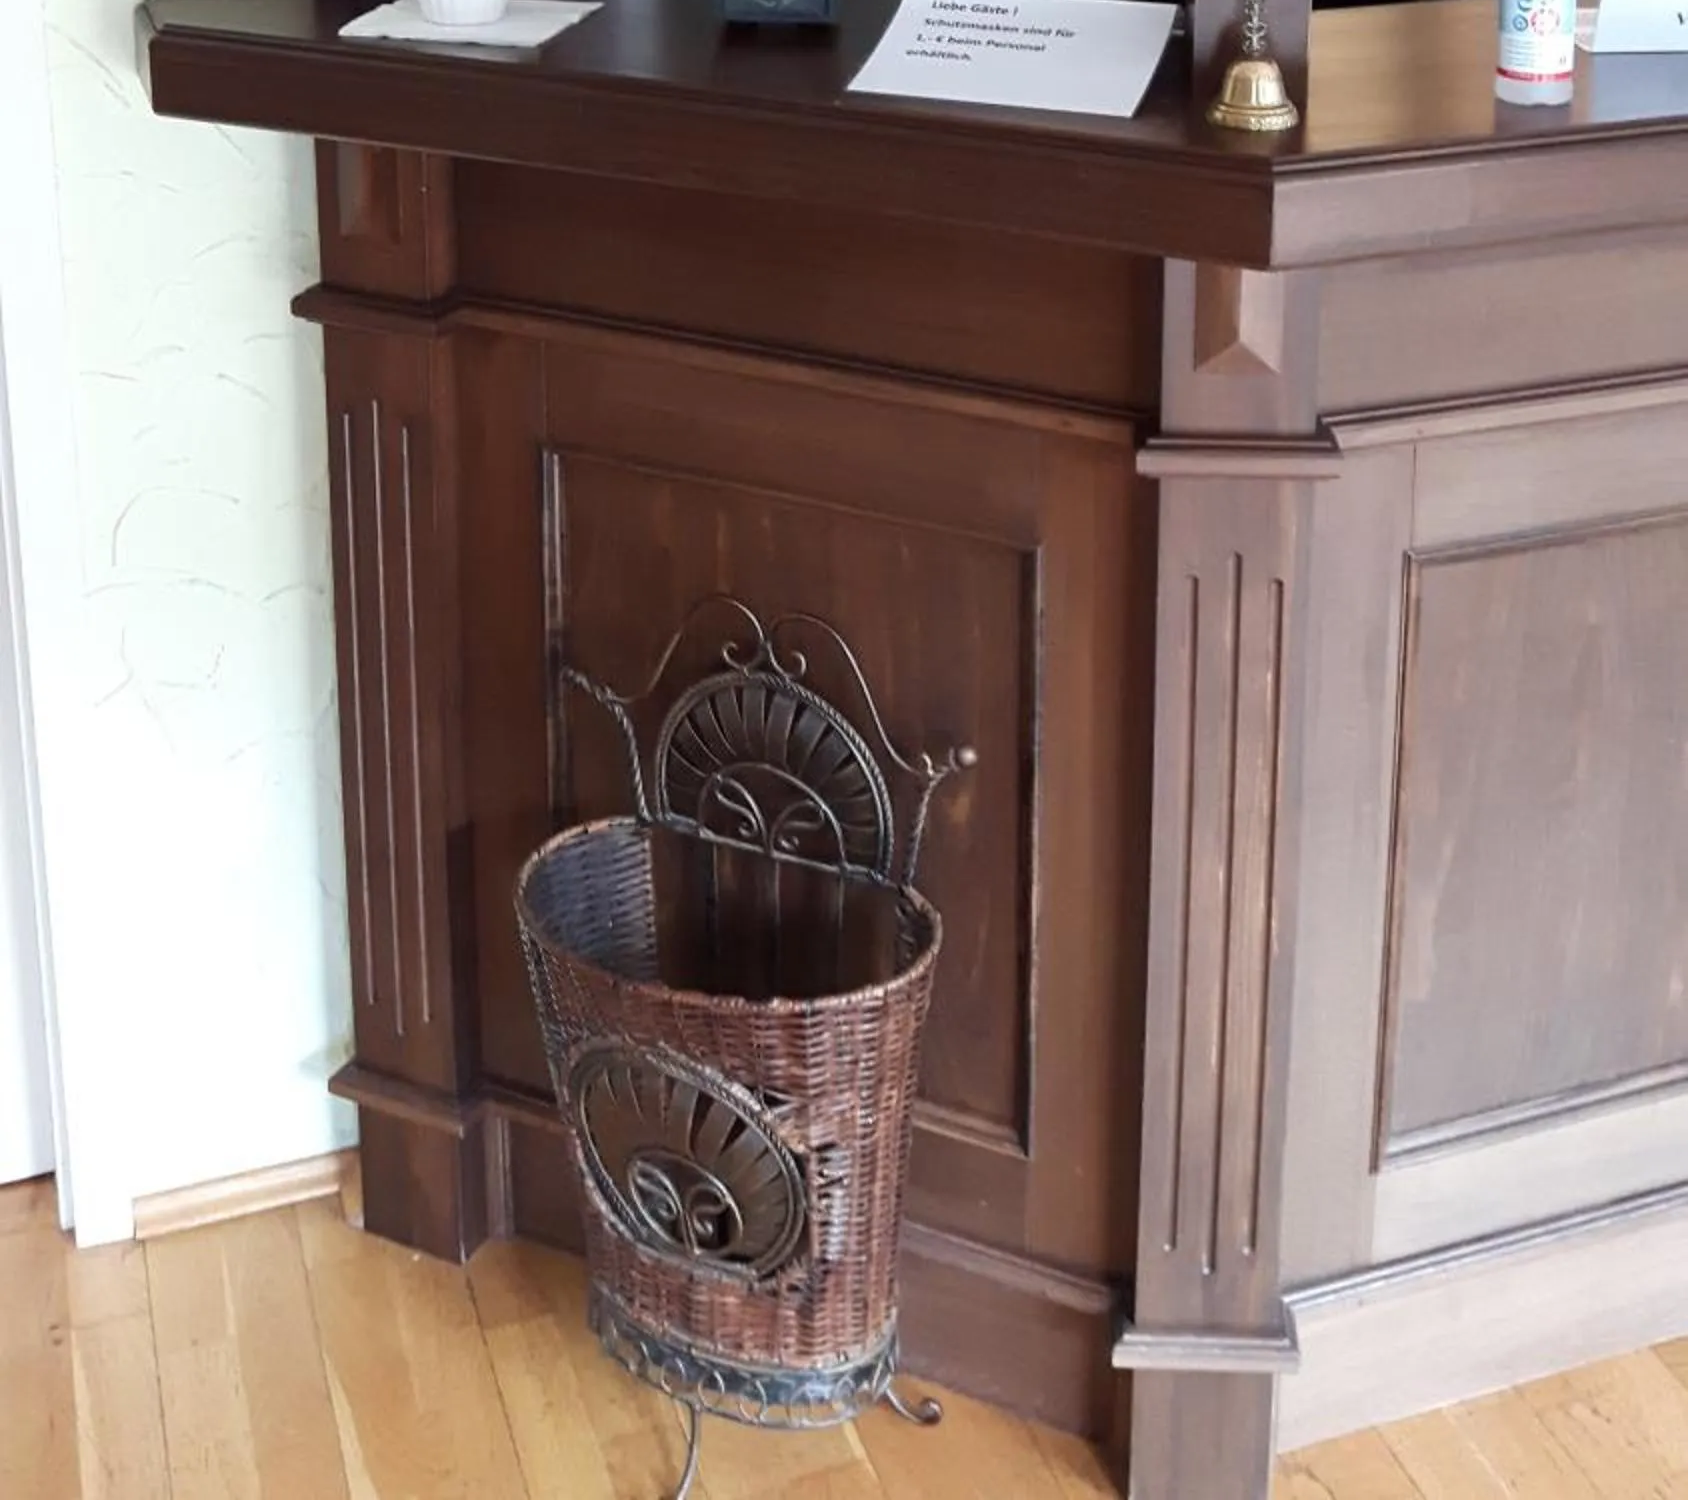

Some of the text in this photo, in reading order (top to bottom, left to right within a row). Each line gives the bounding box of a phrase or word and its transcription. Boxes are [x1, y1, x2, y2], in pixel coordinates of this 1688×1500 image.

[931, 0, 968, 13] Liebe
[970, 3, 1009, 15] Gäste
[924, 17, 1076, 38] Schutzmasken sind für
[947, 36, 982, 47] beim
[985, 40, 1047, 52] Personal
